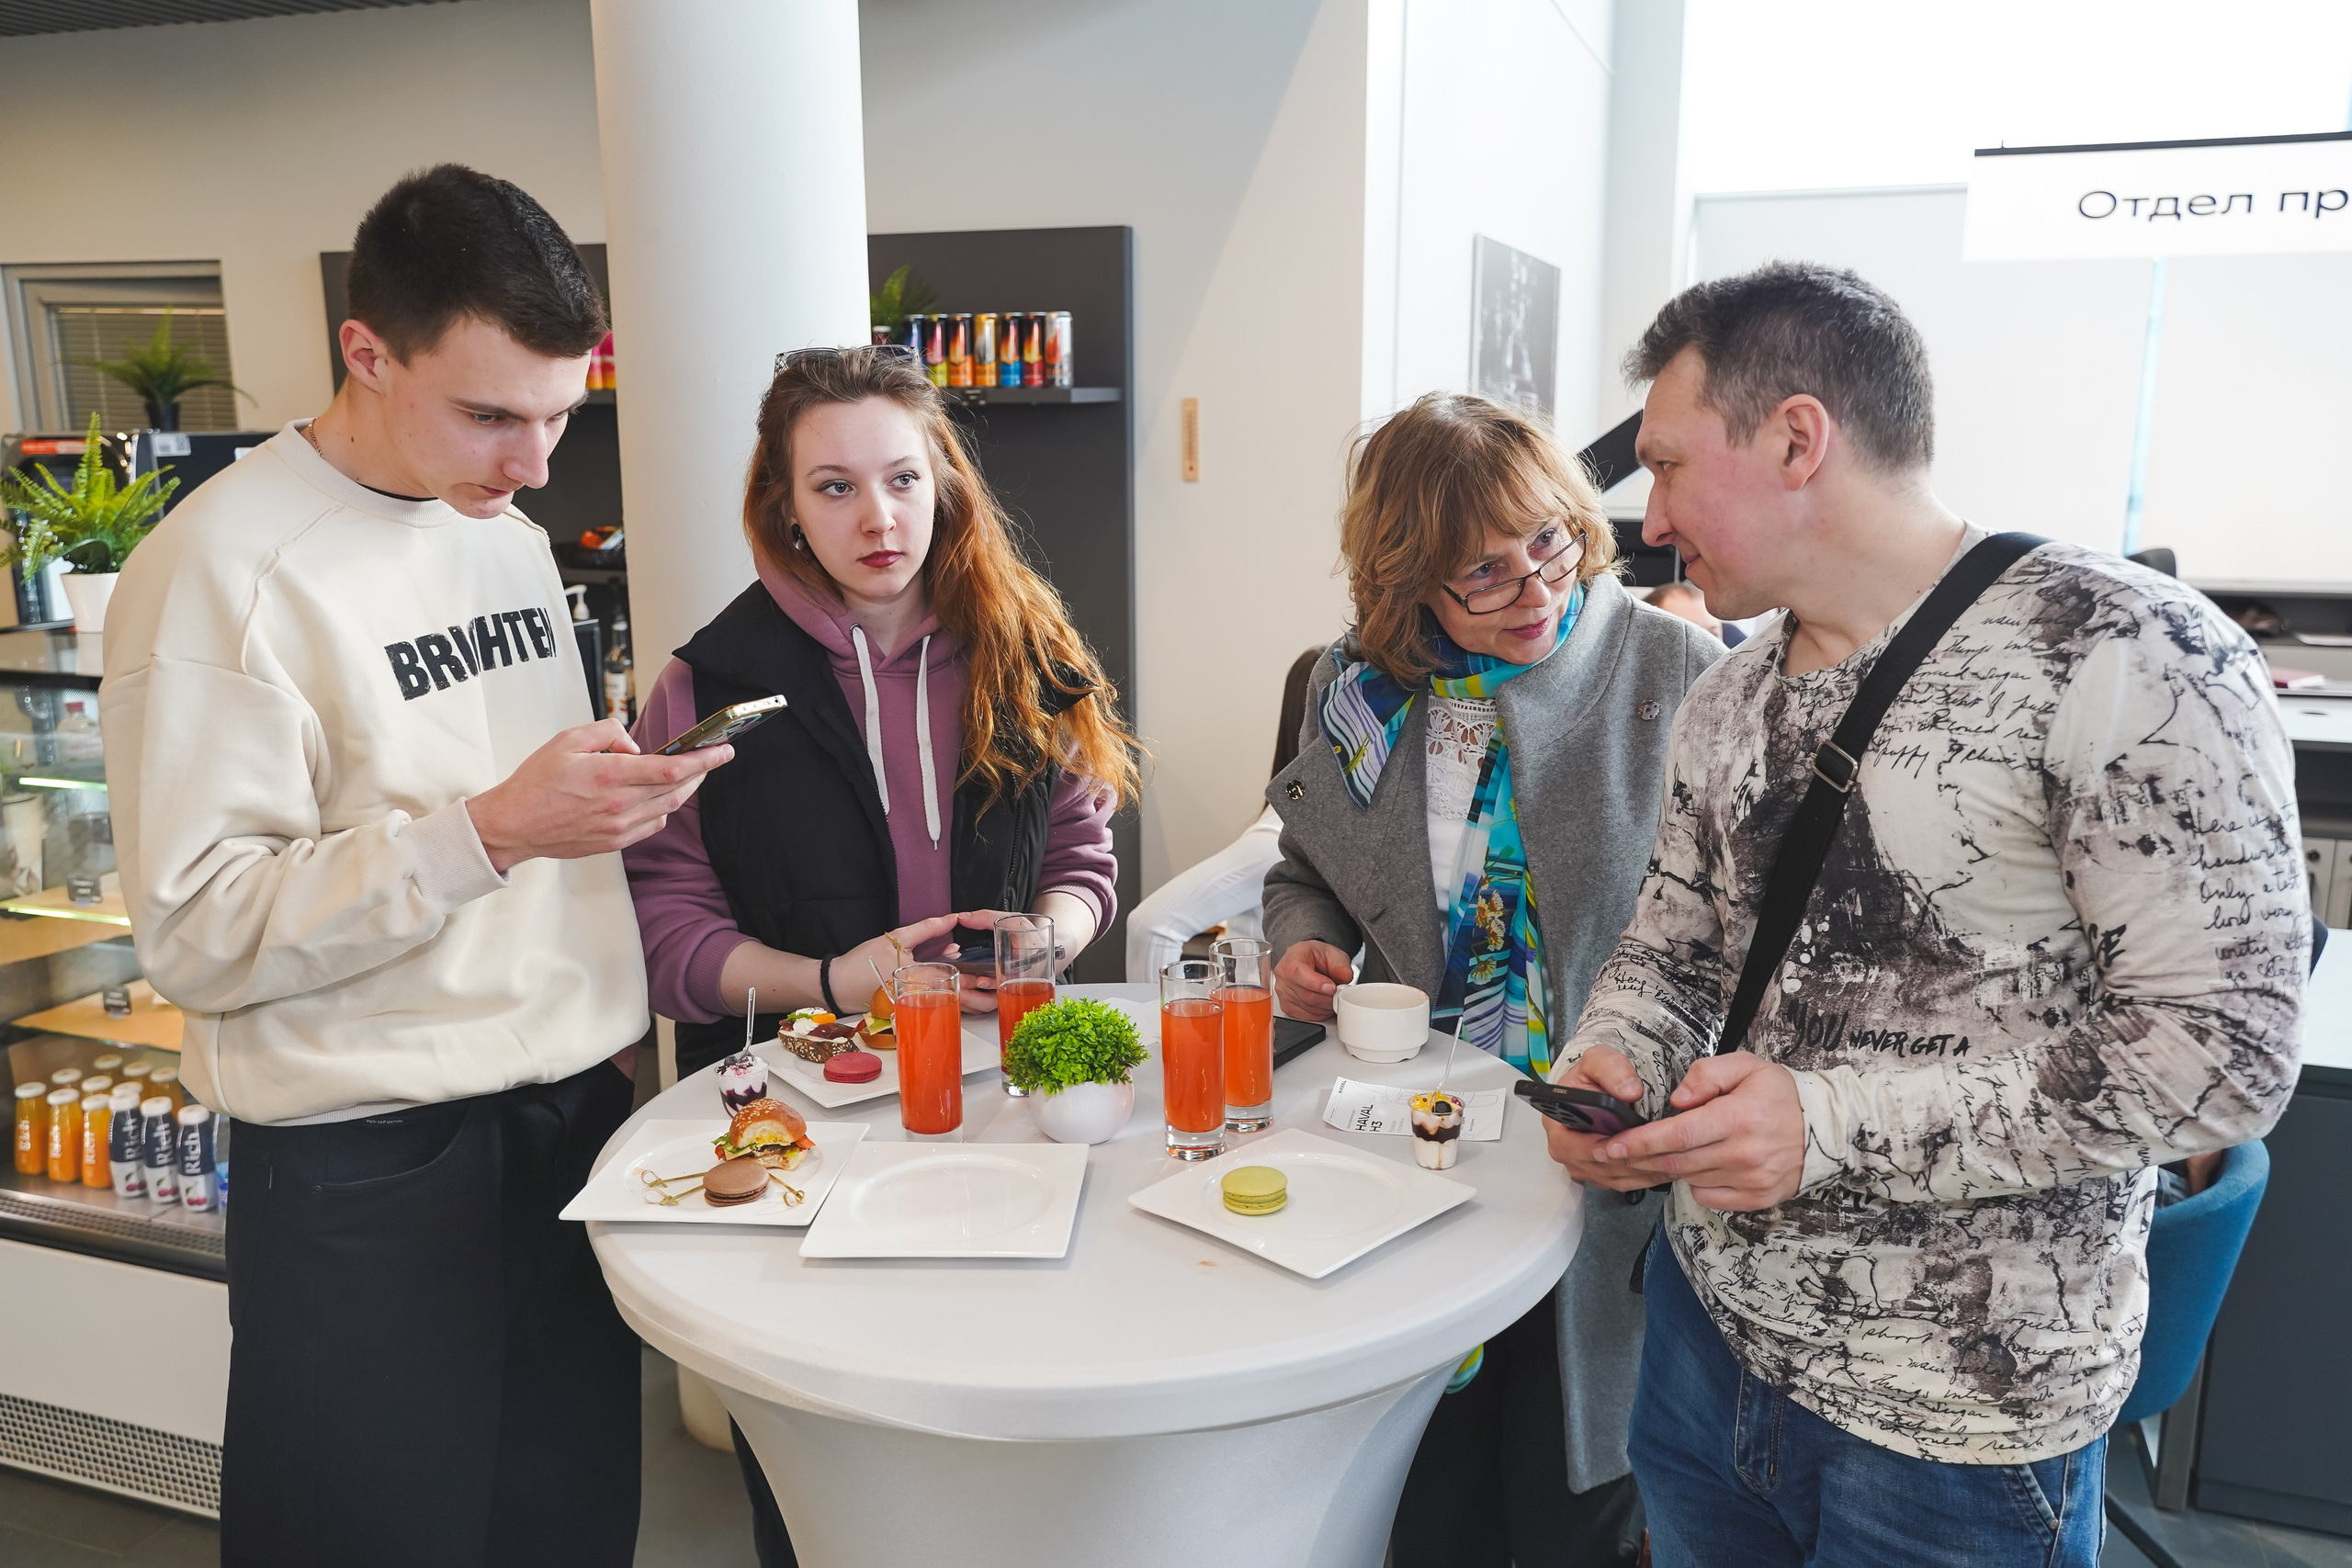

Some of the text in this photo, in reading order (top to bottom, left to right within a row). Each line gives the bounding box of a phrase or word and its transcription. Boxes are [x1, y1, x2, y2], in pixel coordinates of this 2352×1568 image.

[2078, 188, 2350, 222] Отдел пр
[1781, 998, 1971, 1059] YOU NEVER GET A
[1355, 1104, 1374, 1131] HAVAL
[1369, 1121, 1383, 1133] H3
[185, 1131, 201, 1174] Rich
